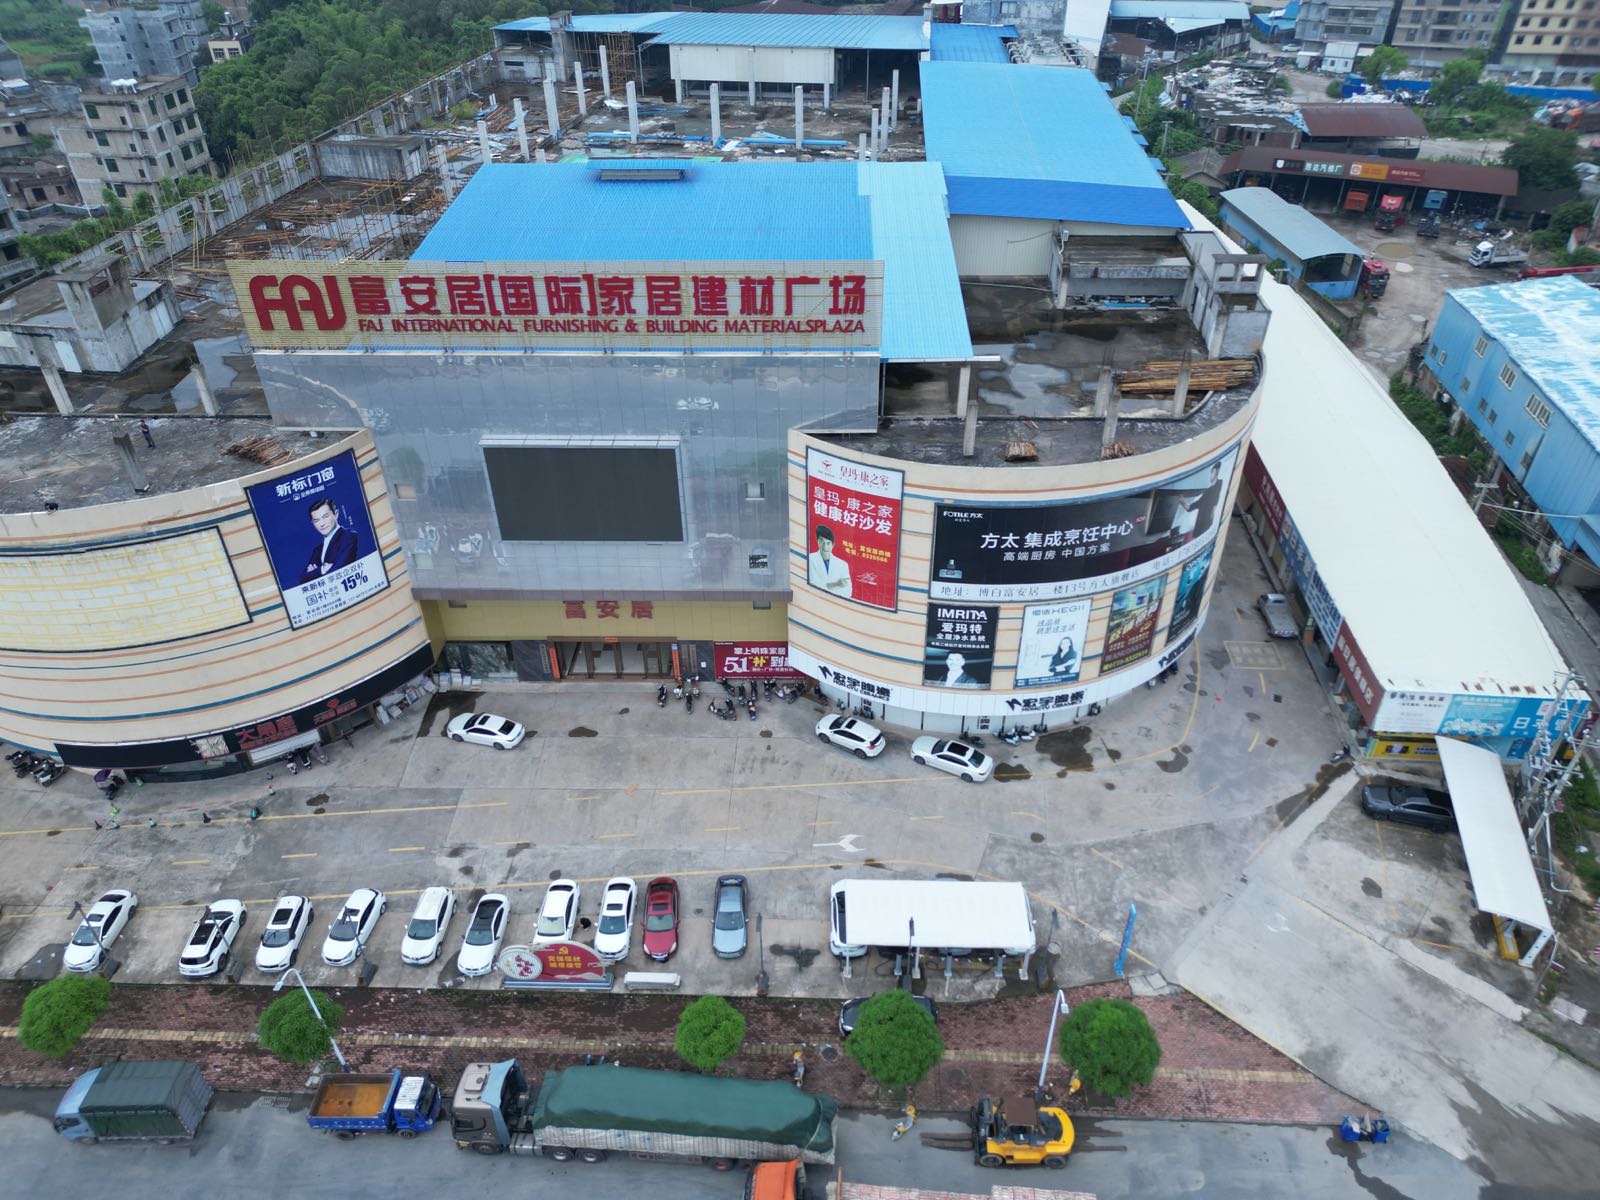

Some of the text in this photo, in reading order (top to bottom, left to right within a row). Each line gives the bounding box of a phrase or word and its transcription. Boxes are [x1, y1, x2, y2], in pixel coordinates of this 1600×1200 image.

[392, 318, 518, 333] INTERNATIONAL
[524, 319, 619, 333] FURNISHING
[624, 319, 639, 333] &
[646, 319, 718, 334] BUILDING
[275, 466, 335, 498] 新标门窗
[813, 485, 893, 519] 皇玛·康之家
[813, 500, 893, 536] 健康好沙发
[943, 510, 969, 518] FOTILE
[980, 519, 1134, 549] 方太 集成烹饪中心
[1003, 543, 1111, 562] 高端厨房 中国方案
[301, 579, 327, 594] 来新标
[305, 590, 327, 607] 国补
[340, 570, 369, 593] 15%
[940, 586, 970, 597] 地址：
[563, 600, 653, 619] 富安居
[937, 608, 988, 620] IMRITA
[941, 622, 983, 634] 爱玛特
[936, 632, 986, 642] 全屋净水系统
